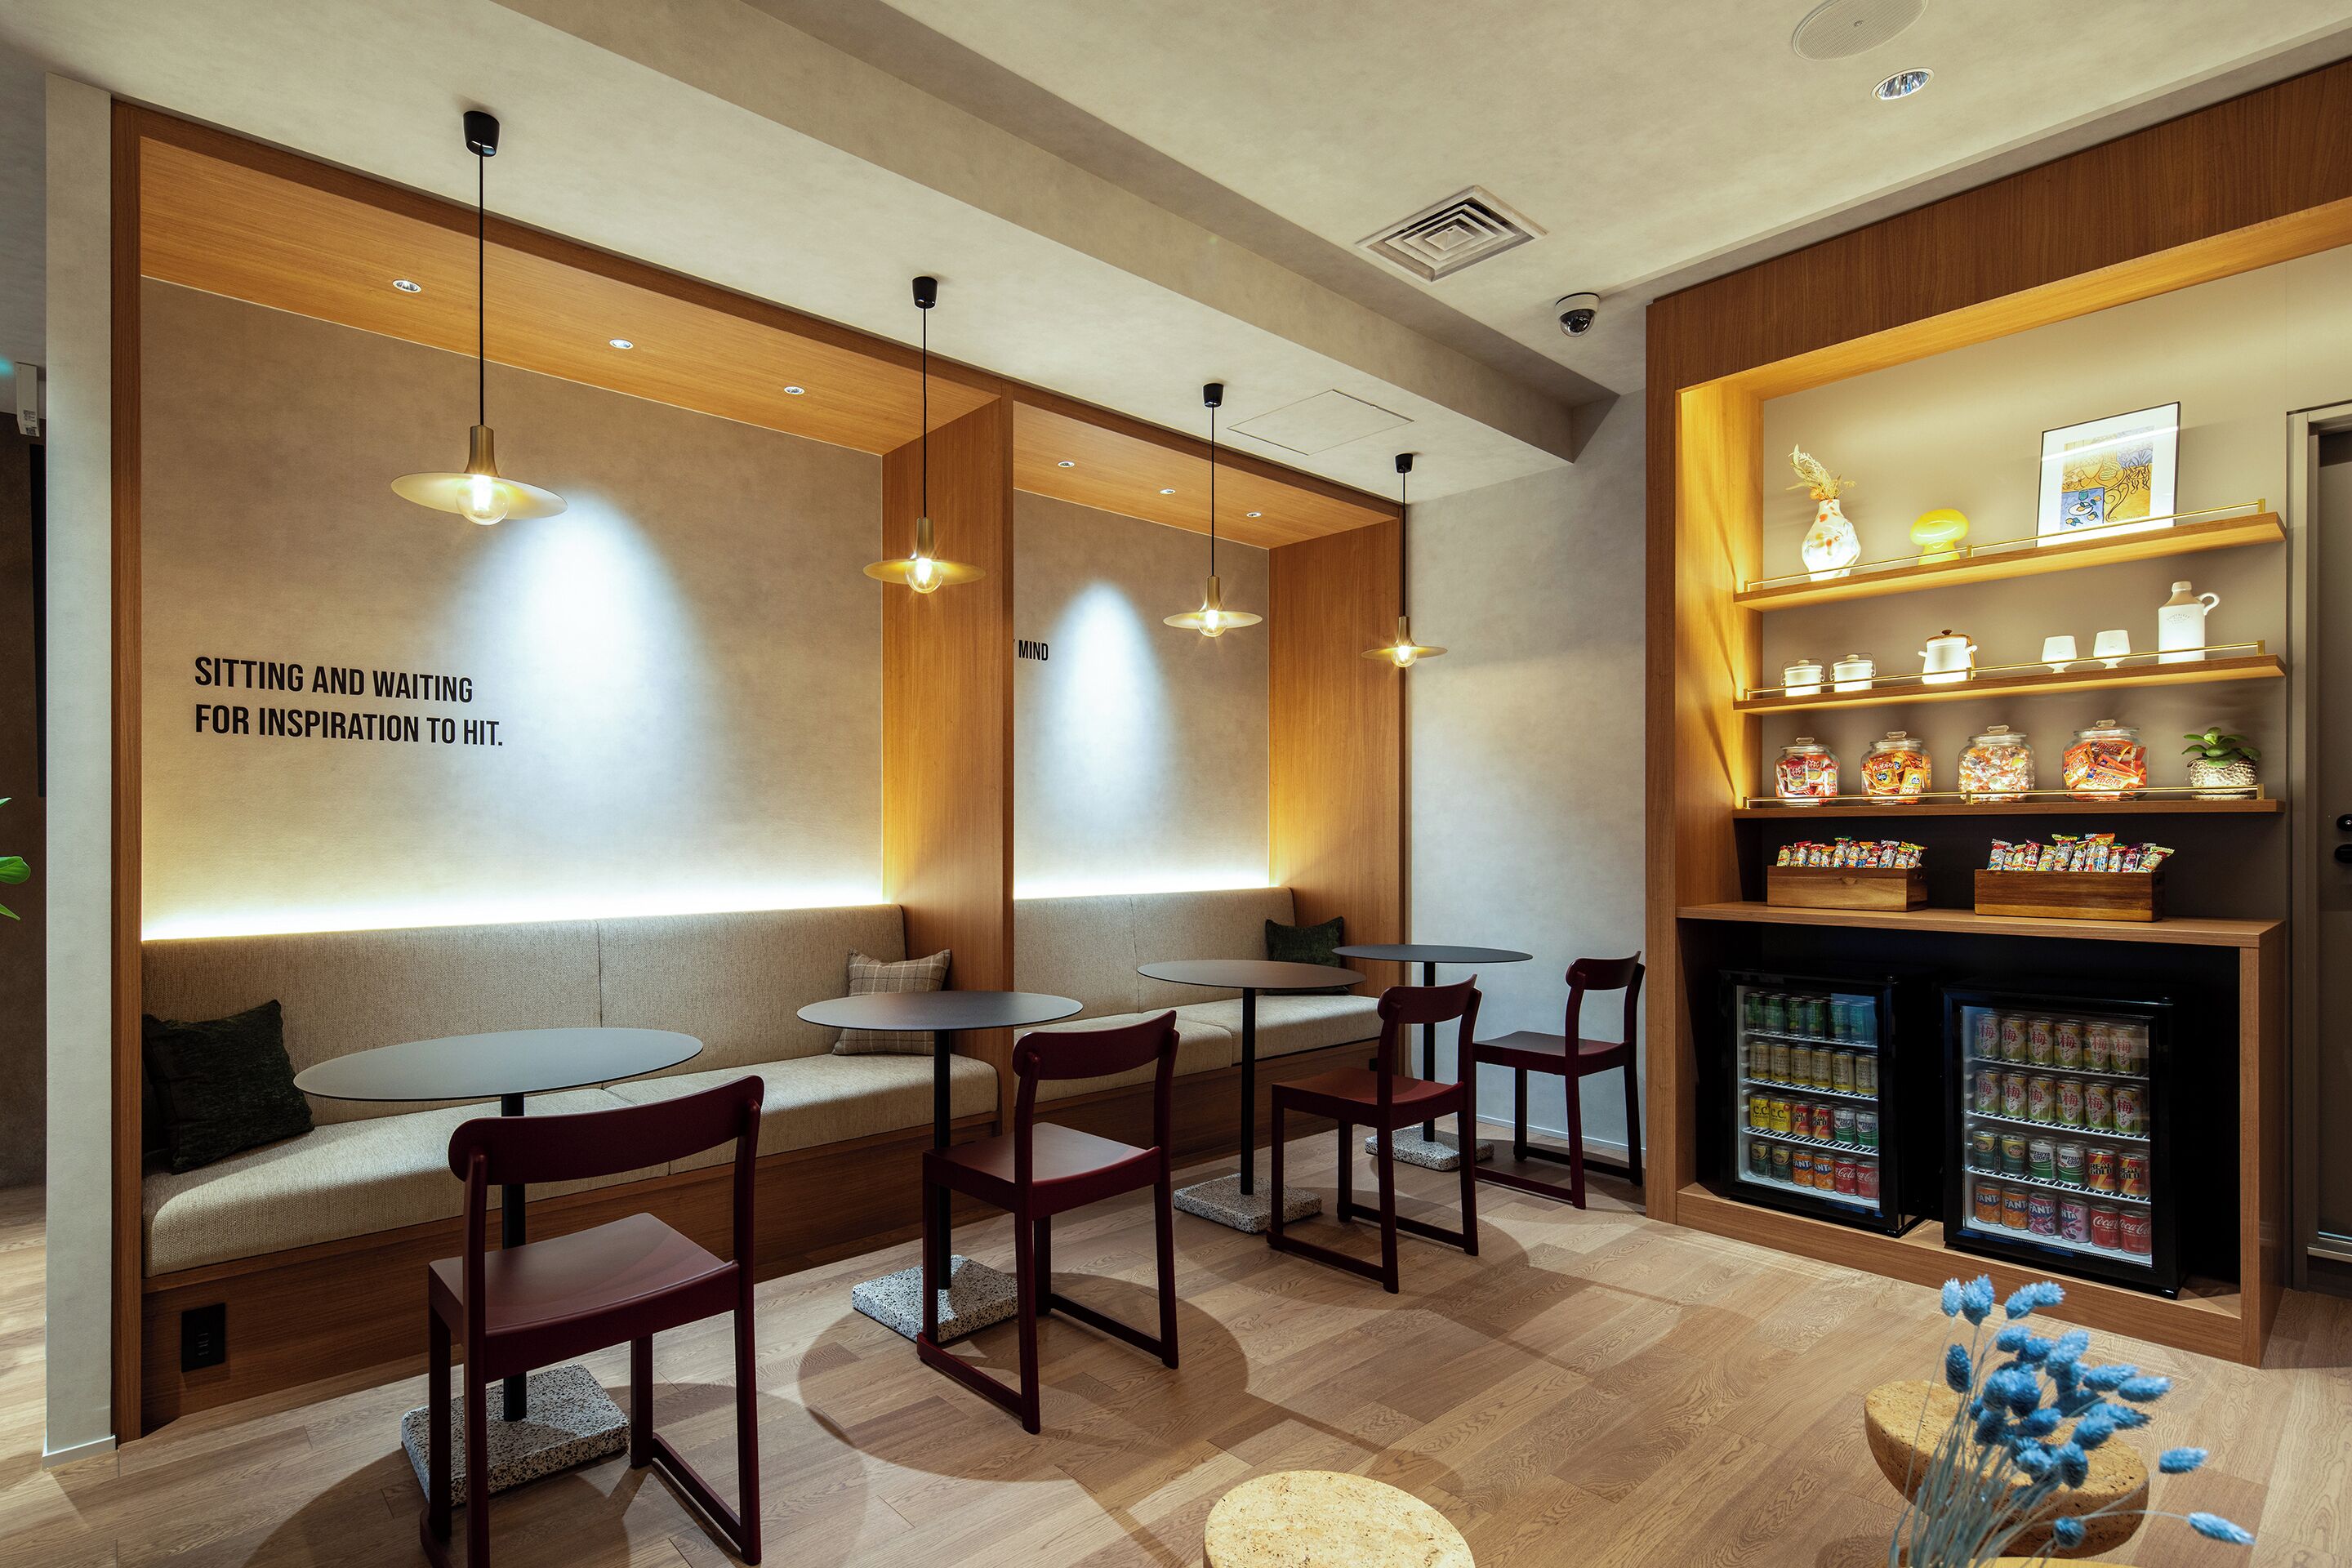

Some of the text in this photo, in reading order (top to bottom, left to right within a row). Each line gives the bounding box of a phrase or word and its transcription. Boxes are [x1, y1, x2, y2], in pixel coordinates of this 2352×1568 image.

[1018, 639, 1049, 662] MIND
[194, 657, 474, 703] SITTING AND WAITING
[194, 704, 503, 746] FOR INSPIRATION TO HIT.
